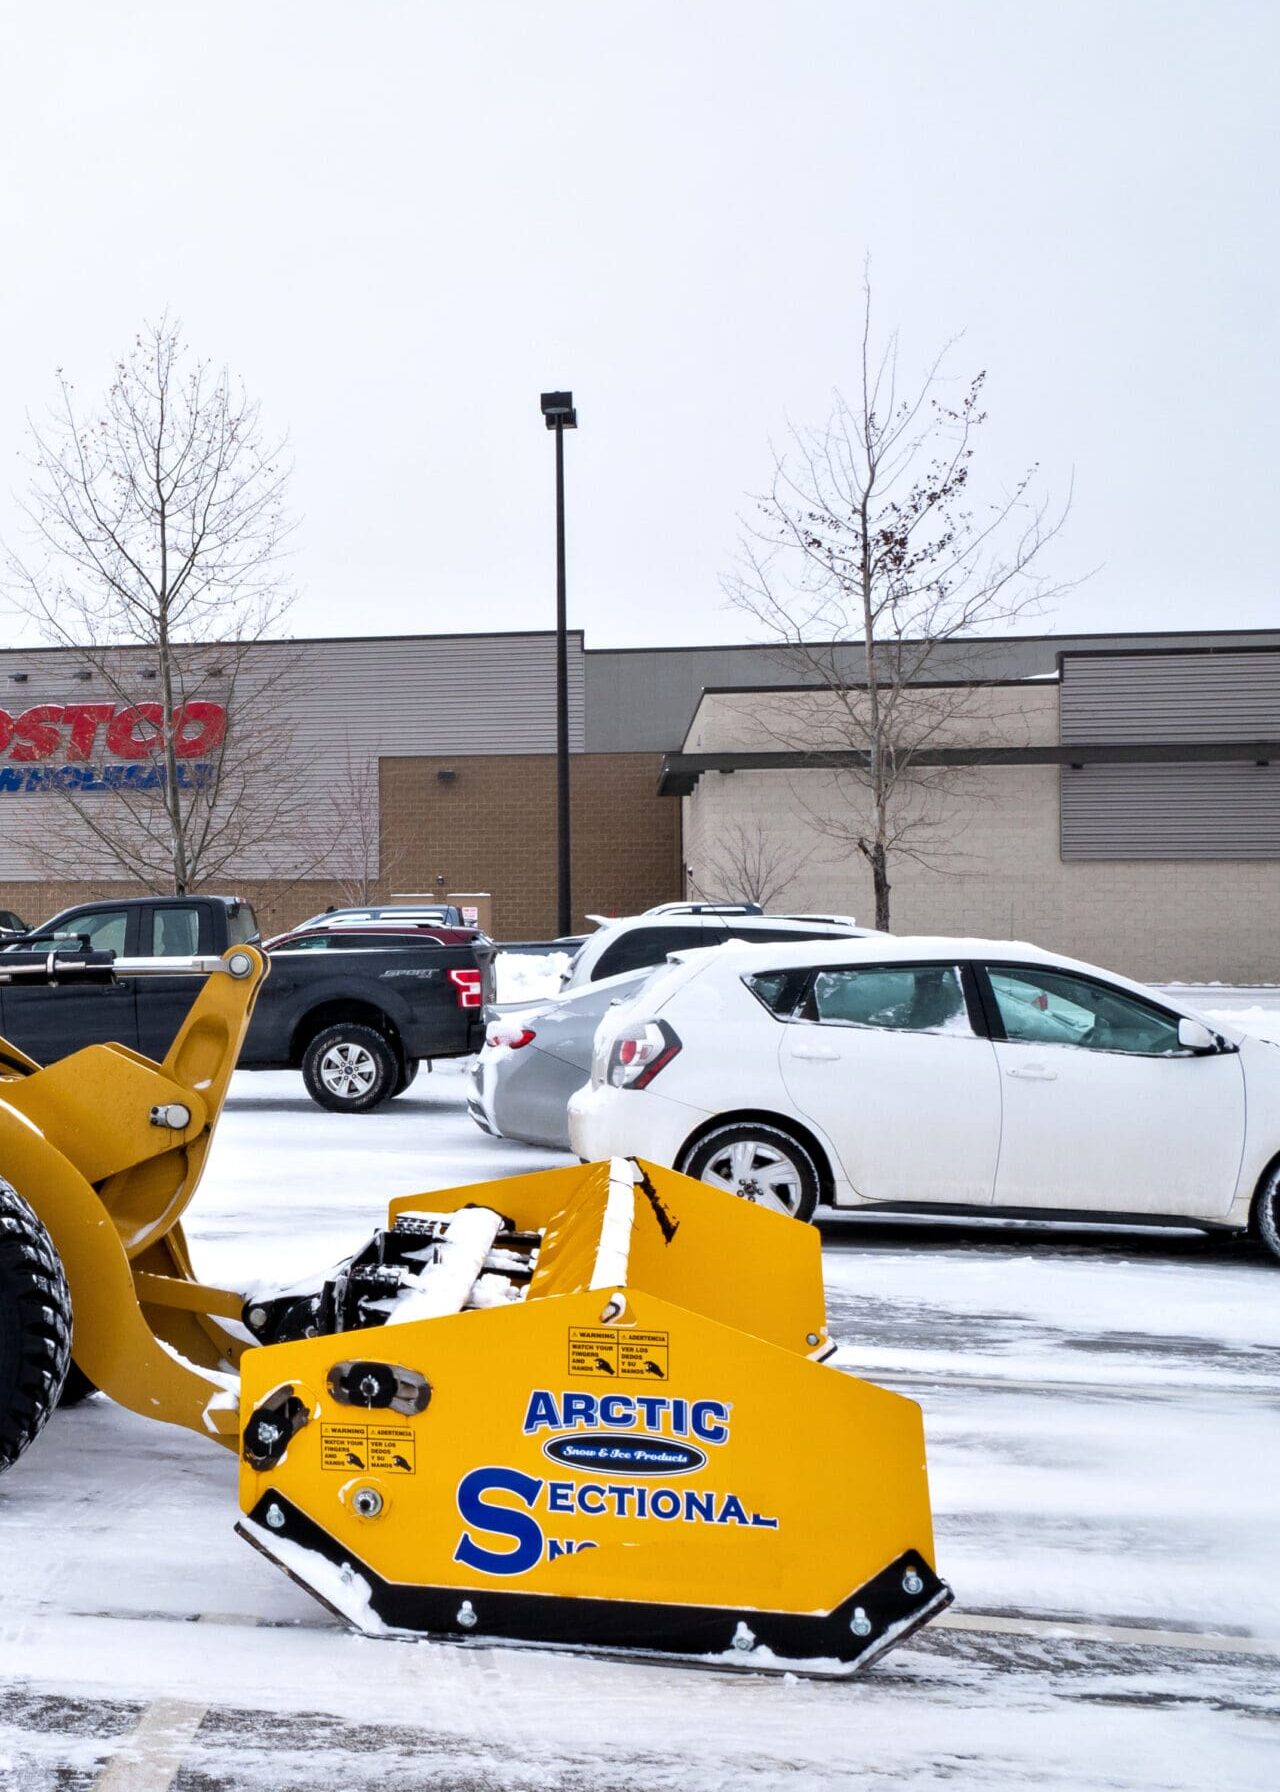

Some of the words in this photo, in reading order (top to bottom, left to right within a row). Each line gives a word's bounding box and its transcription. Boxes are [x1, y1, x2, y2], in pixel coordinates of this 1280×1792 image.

[524, 1390, 729, 1445] ARCTIC
[563, 1446, 596, 1457] Snow
[598, 1448, 609, 1458] &
[610, 1449, 631, 1460] Ice
[634, 1451, 688, 1464] Products
